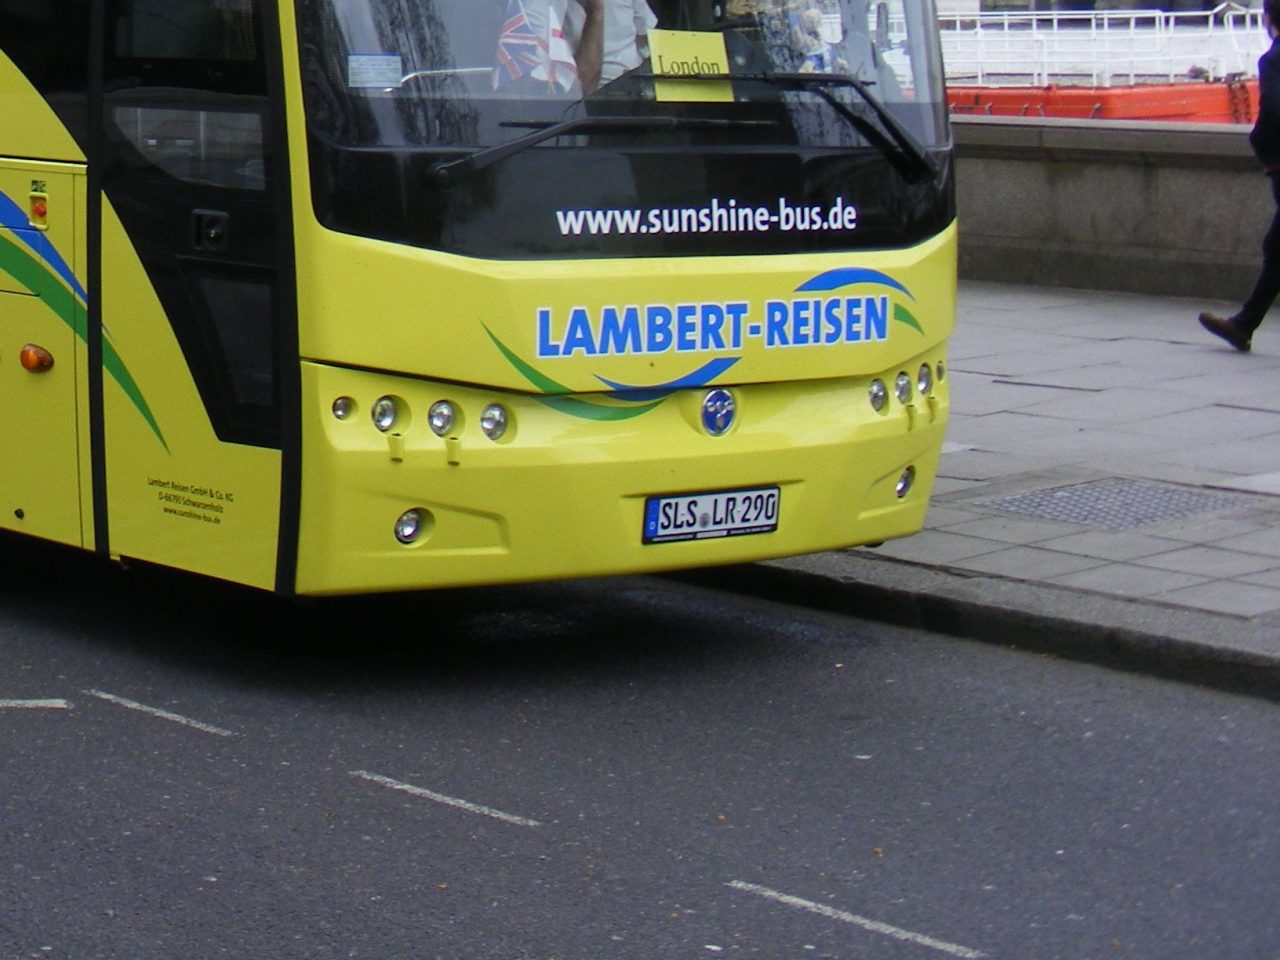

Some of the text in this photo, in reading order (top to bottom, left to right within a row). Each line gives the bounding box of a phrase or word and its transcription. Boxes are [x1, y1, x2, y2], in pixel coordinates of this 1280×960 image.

[658, 55, 721, 75] London
[556, 197, 857, 235] www.sunshine-bus.de
[537, 295, 889, 360] LAMBERT-REISEN
[660, 500, 698, 529] SLS
[740, 493, 776, 522] 290
